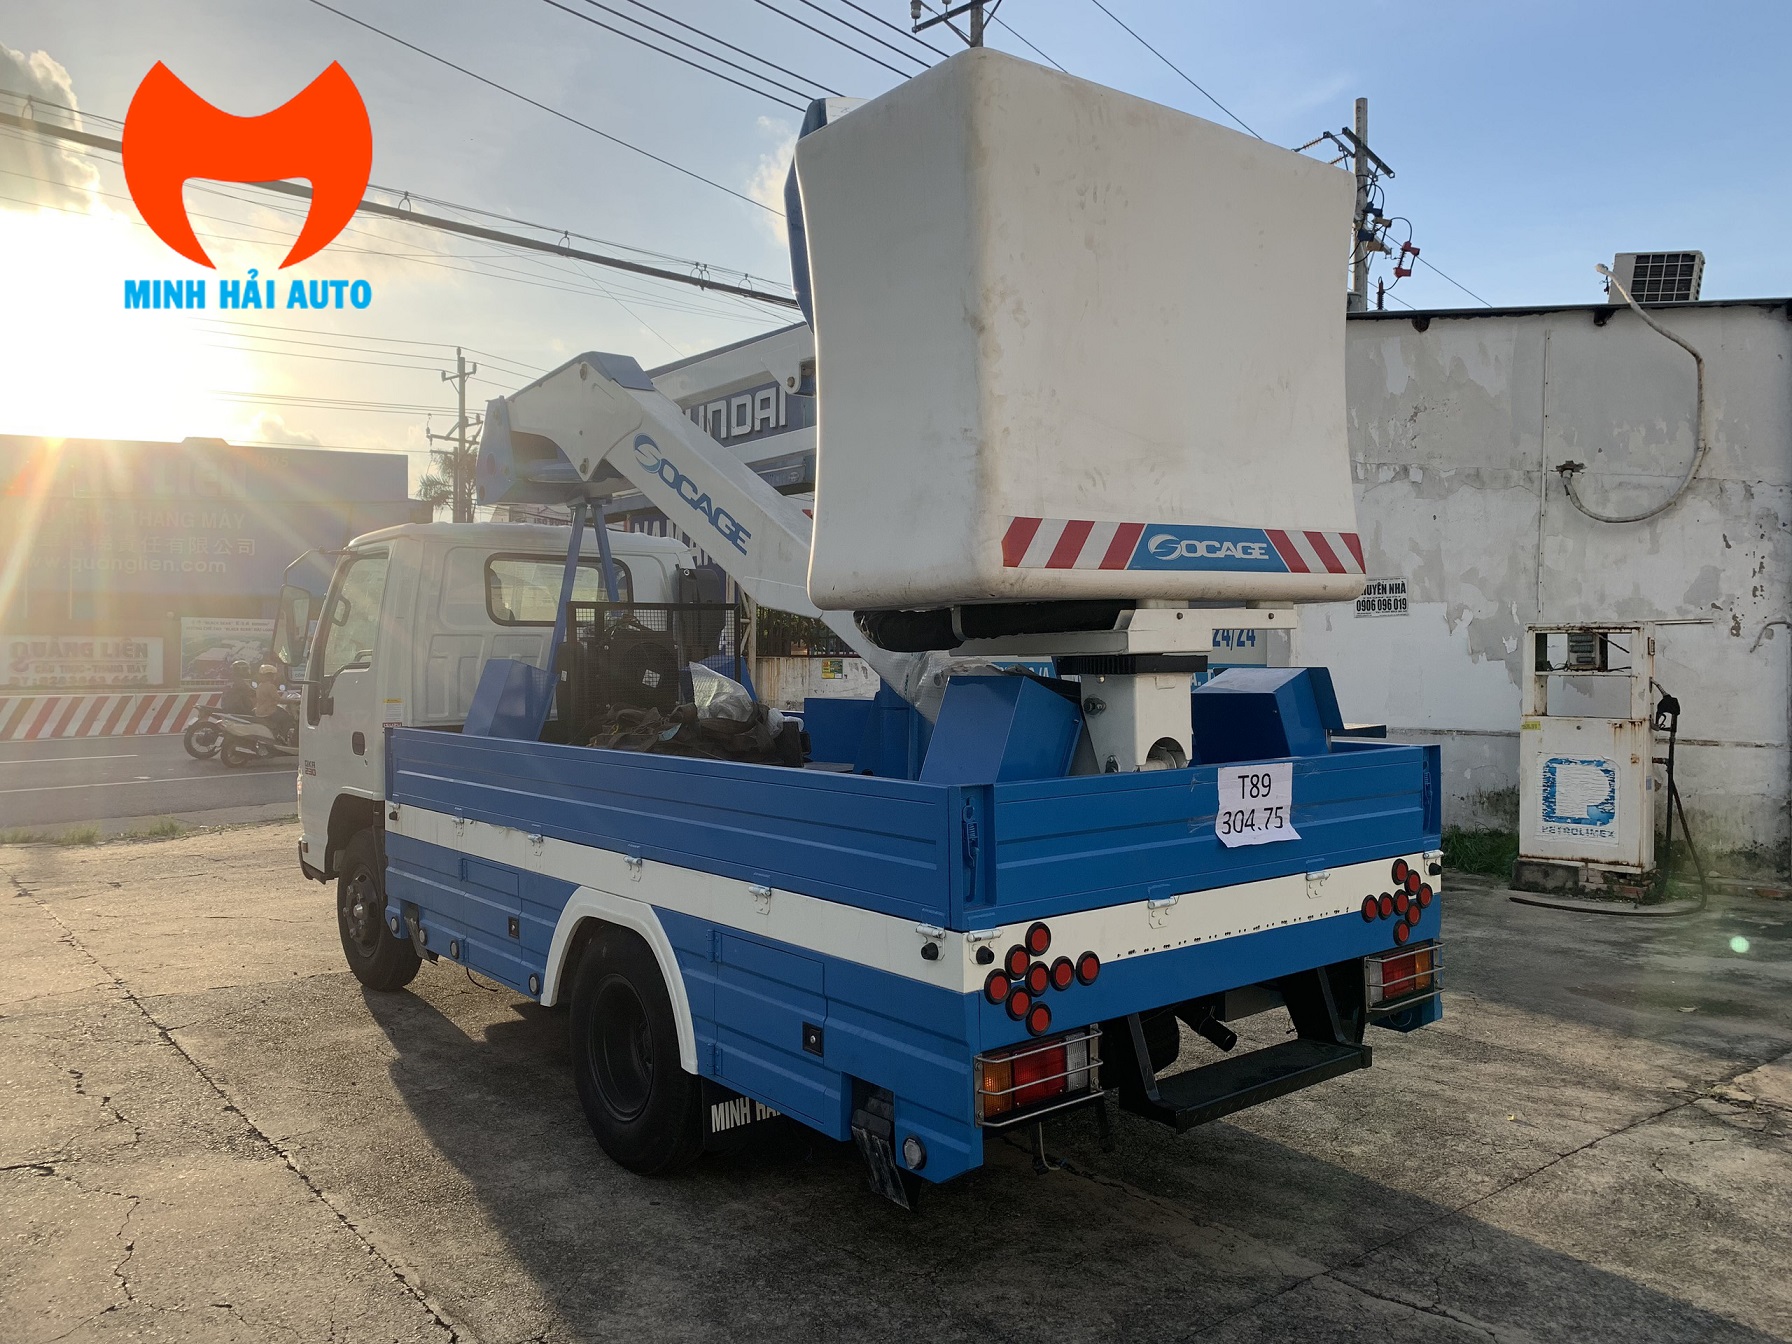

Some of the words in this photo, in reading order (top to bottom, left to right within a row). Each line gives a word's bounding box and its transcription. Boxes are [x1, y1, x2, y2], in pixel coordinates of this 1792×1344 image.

[634, 433, 751, 556] SOCAGE
[1148, 533, 1269, 561] SOCAGE
[1389, 581, 1407, 595] NHÀ
[1356, 599, 1376, 612] 0906
[1377, 599, 1392, 611] 096
[1394, 598, 1407, 611] 019
[1238, 773, 1272, 799] T89
[1221, 806, 1284, 835] 304.75
[711, 1097, 751, 1133] MINH
